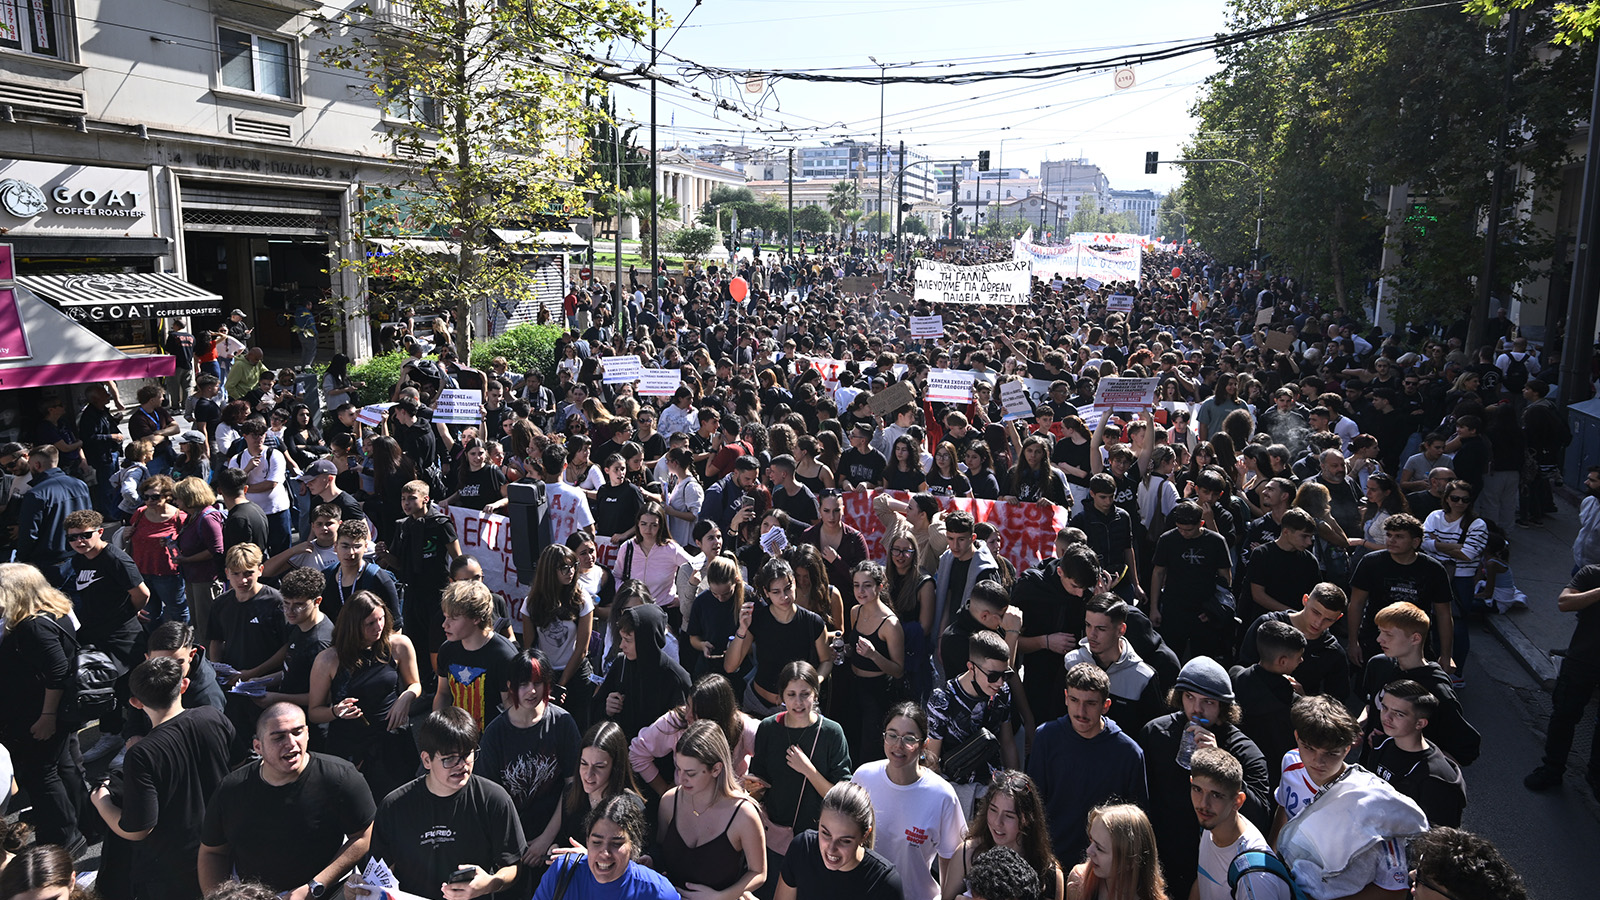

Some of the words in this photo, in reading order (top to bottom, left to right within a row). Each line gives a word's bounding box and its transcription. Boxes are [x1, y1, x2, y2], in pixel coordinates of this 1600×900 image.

[33, 0, 46, 48] ΩΛΕΙΤΑΙ
[196, 153, 261, 171] ΜΕΓΑΡΟΝ
[53, 186, 141, 207] GOAT
[55, 207, 96, 216] COFFEE
[98, 208, 147, 218] ROASTERS
[915, 260, 936, 271] ΑΠΟ
[996, 261, 1031, 272] ΜΕΧΡΙ
[940, 272, 952, 281] ΤΗ
[956, 271, 989, 282] ΓΑΛΛΙΑ
[964, 282, 977, 292] ΓΙΑ
[981, 282, 1012, 293] ΔΩΡΕΑΝ
[943, 292, 981, 302] ΠΑΙΔΕΙΑ
[90, 304, 154, 319] GOAT
[78, 570, 97, 581] NIKE
[1285, 786, 1300, 816] 12
[913, 826, 926, 834] THE
[906, 836, 925, 845] SHOW
